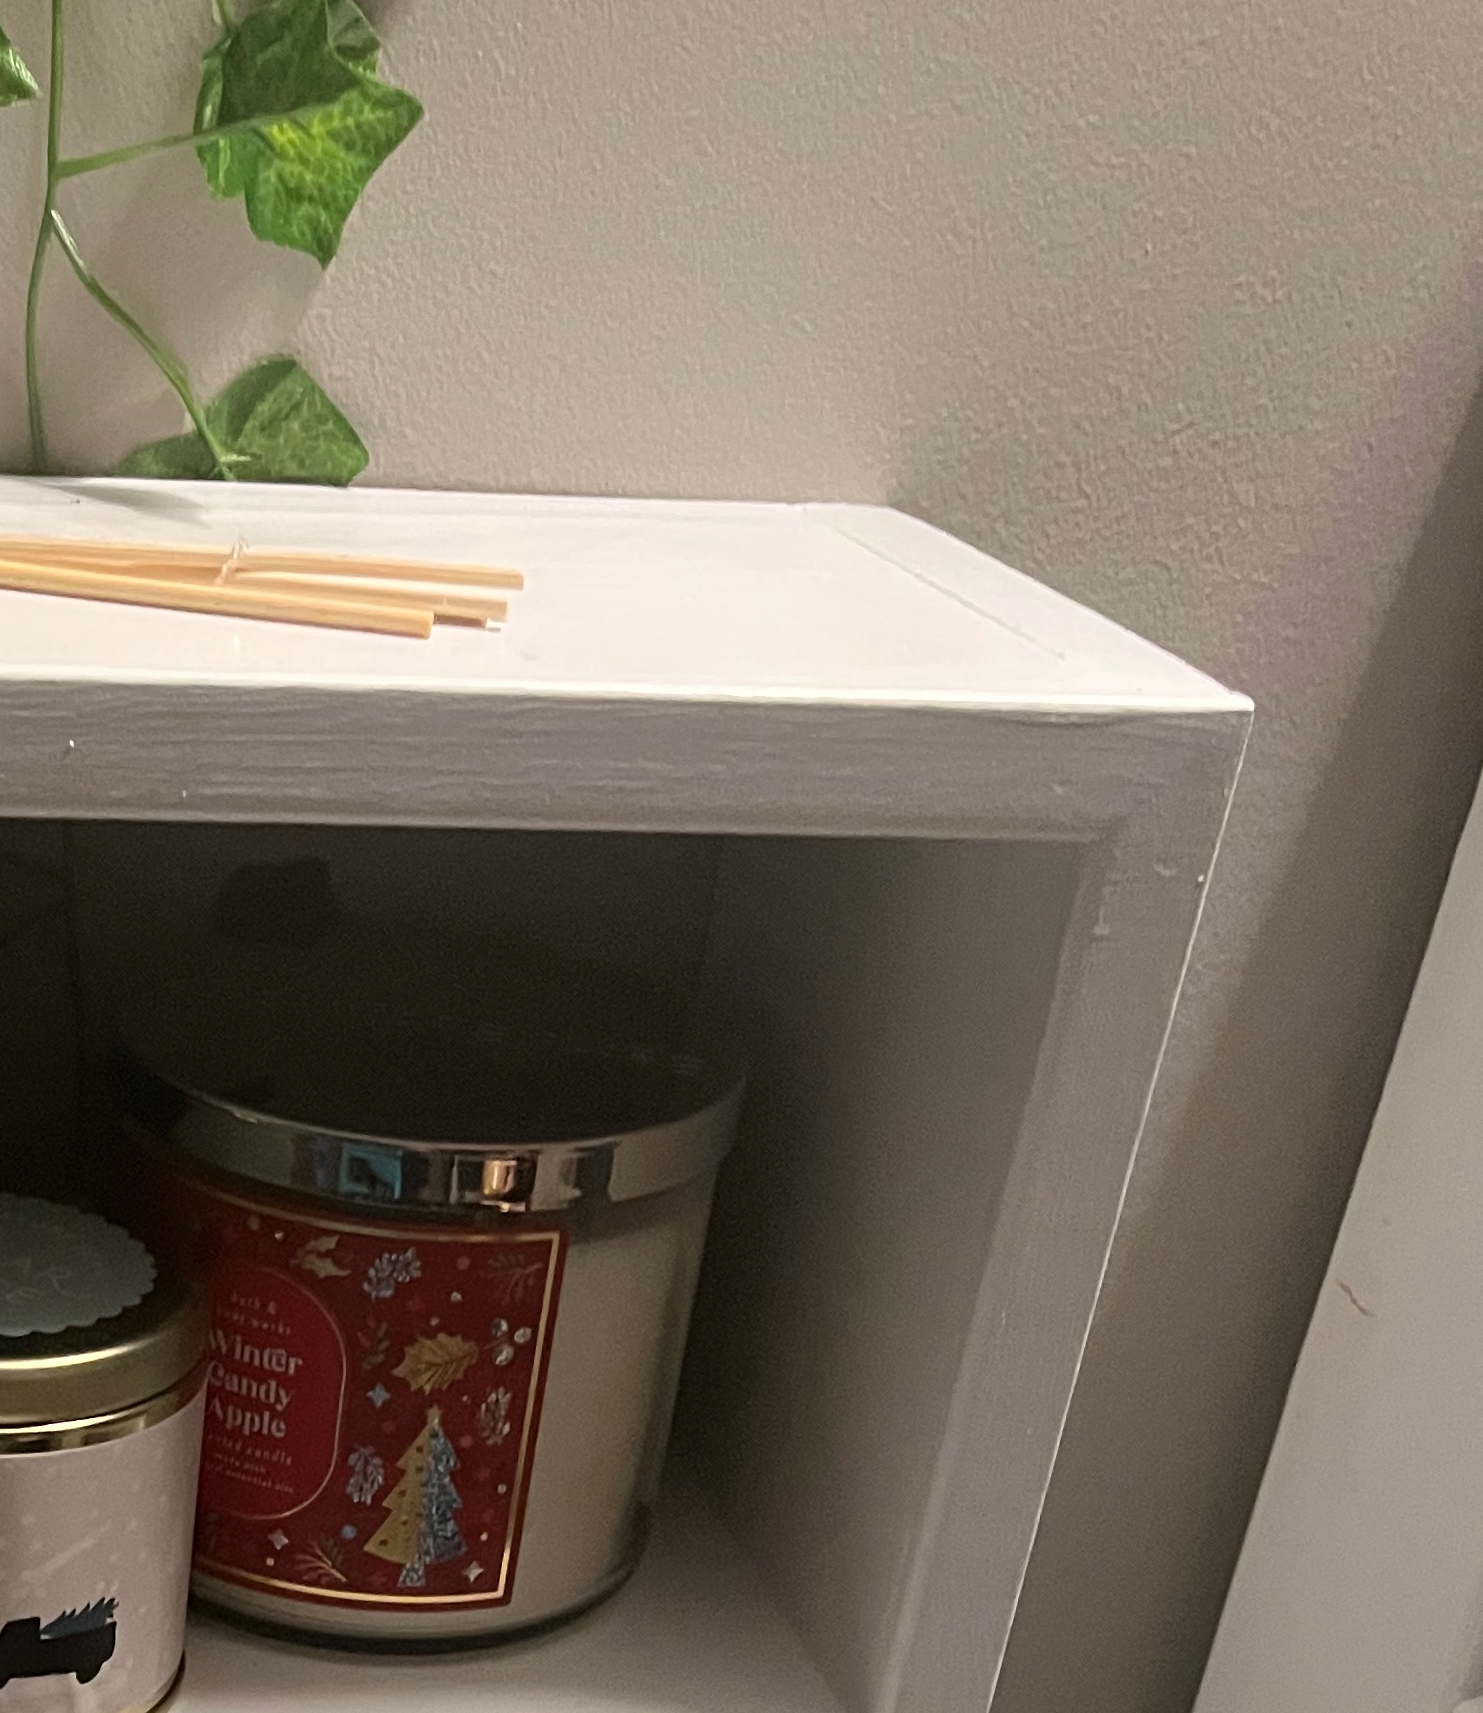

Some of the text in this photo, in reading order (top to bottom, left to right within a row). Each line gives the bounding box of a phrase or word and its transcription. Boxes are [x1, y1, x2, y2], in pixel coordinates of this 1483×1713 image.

[207, 1328, 304, 1377] Winter
[205, 1360, 294, 1413] Candy
[206, 1396, 287, 1439] Apple
